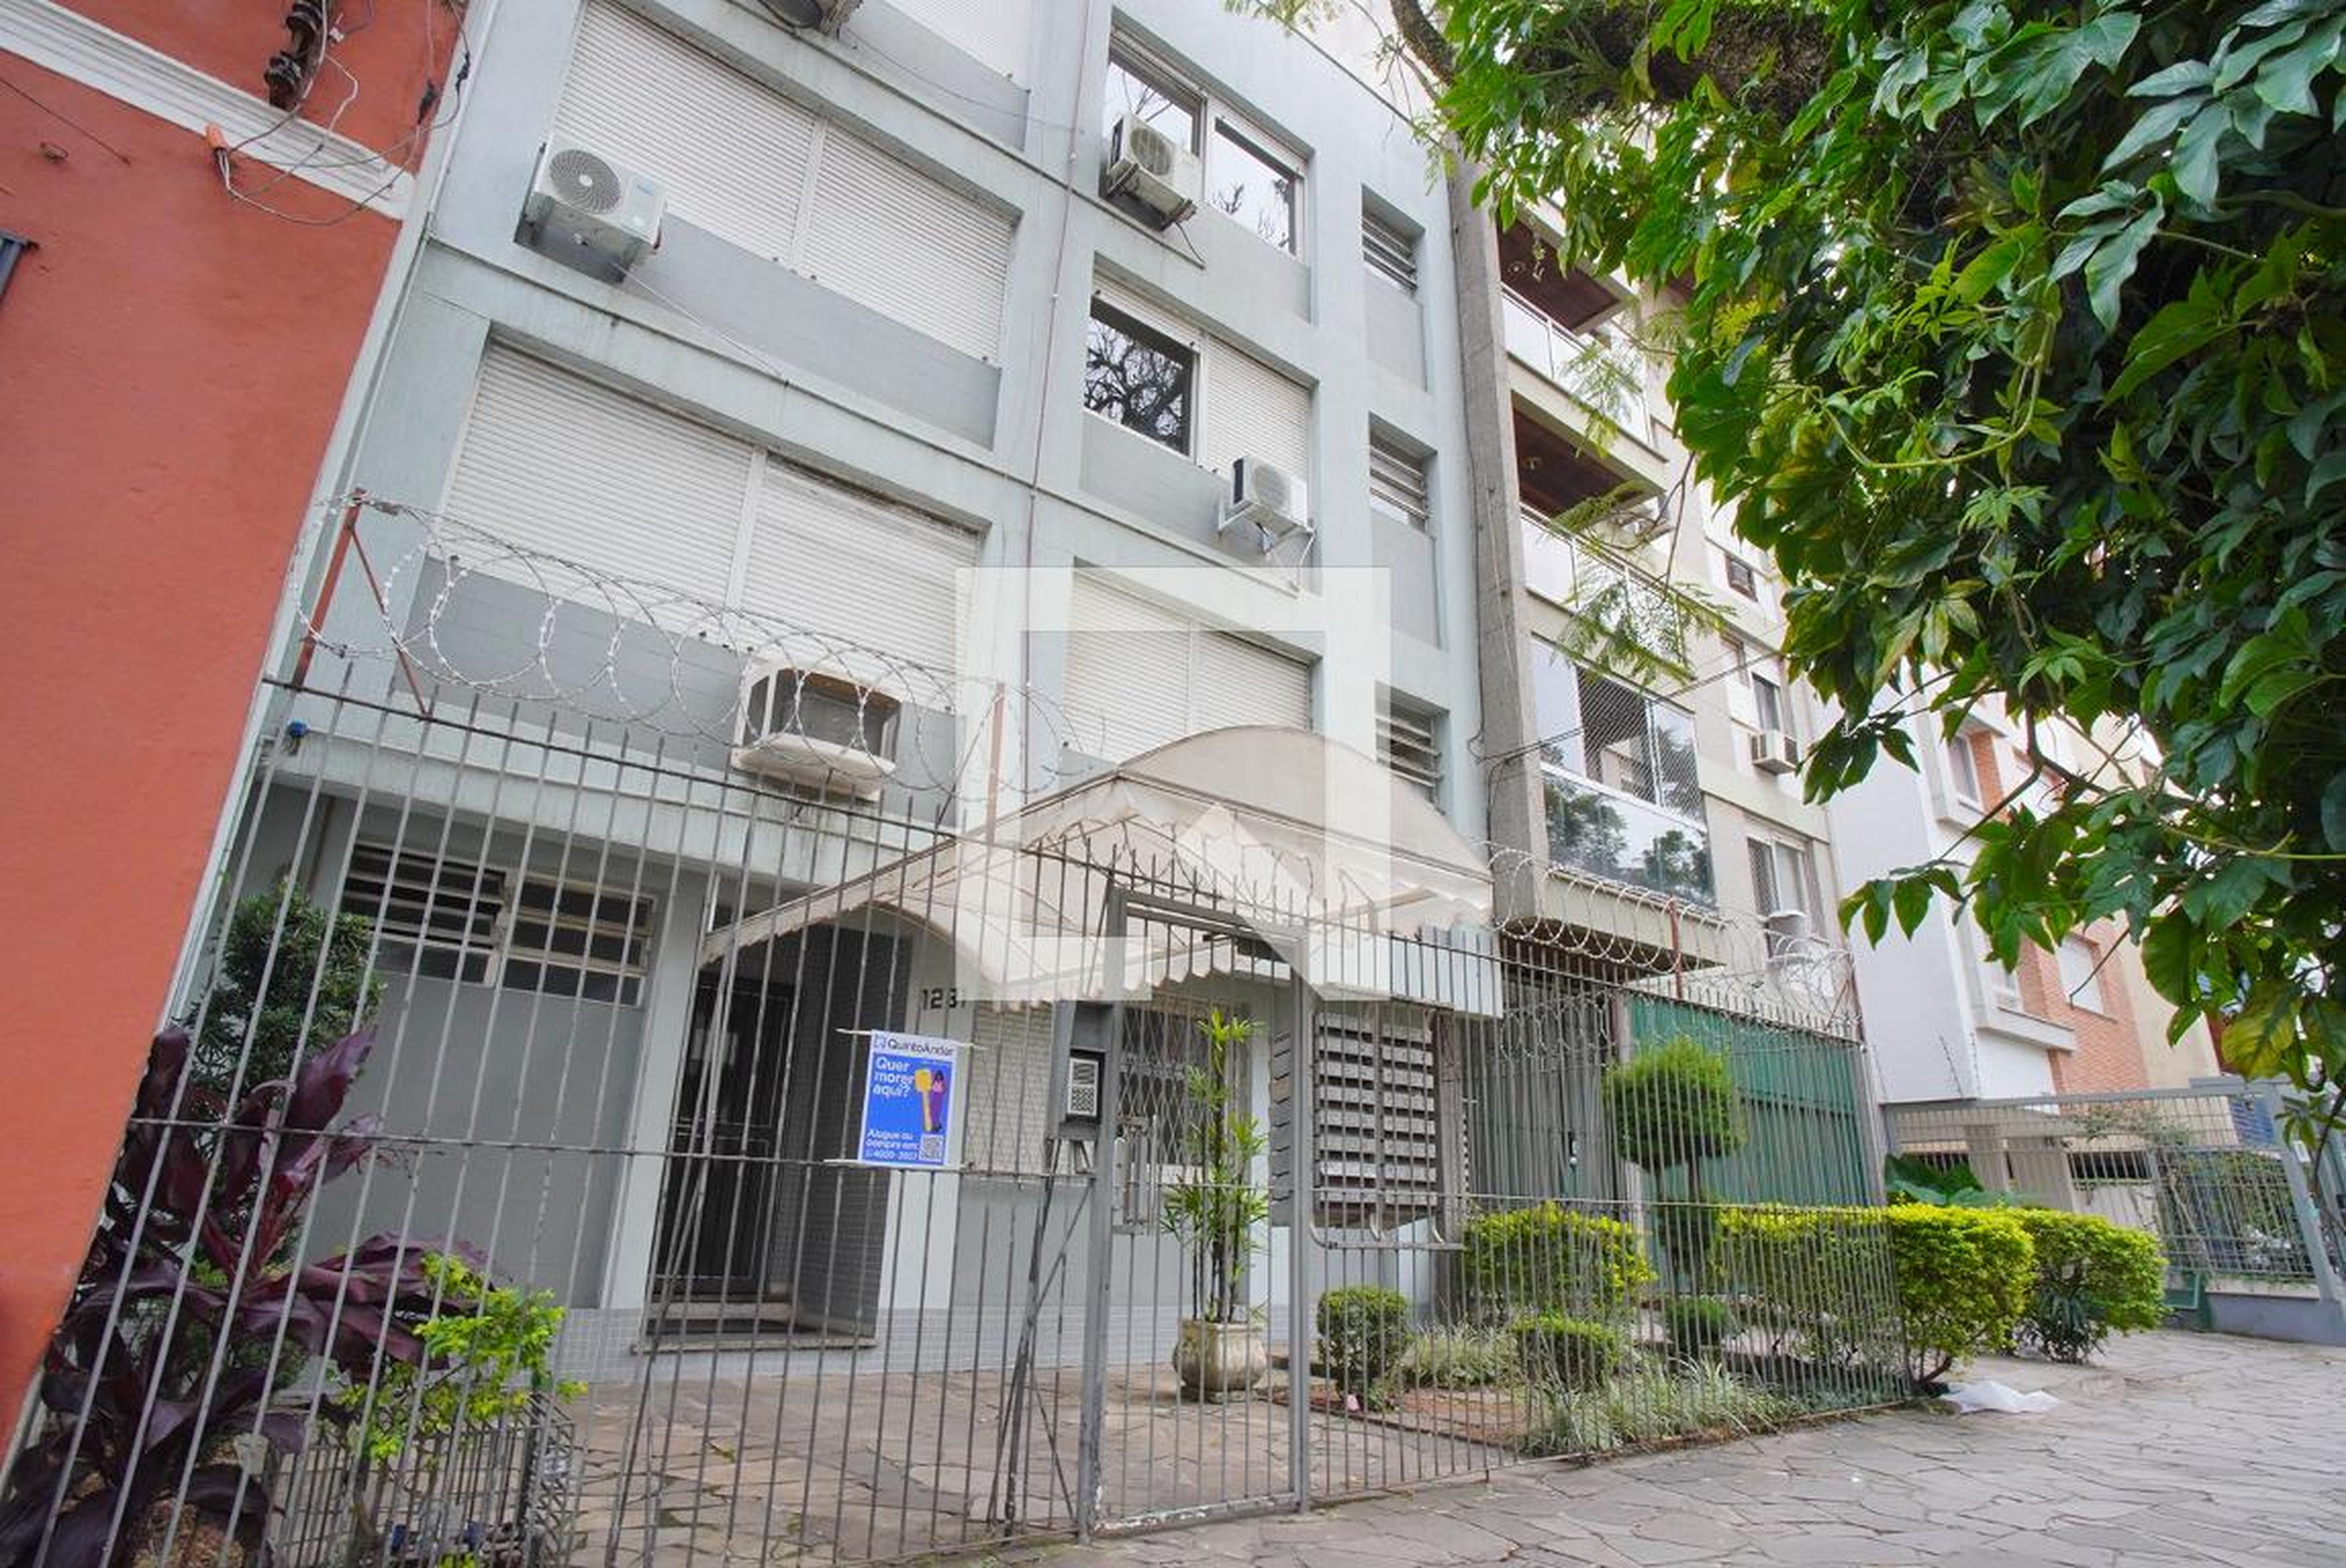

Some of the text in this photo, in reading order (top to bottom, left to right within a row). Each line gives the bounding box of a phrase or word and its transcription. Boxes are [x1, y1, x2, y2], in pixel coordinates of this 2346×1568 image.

[888, 1038, 953, 1056] QuintoAndar
[875, 1056, 910, 1072] Quer
[874, 1071, 915, 1084] morar
[873, 1082, 910, 1098] aqui?
